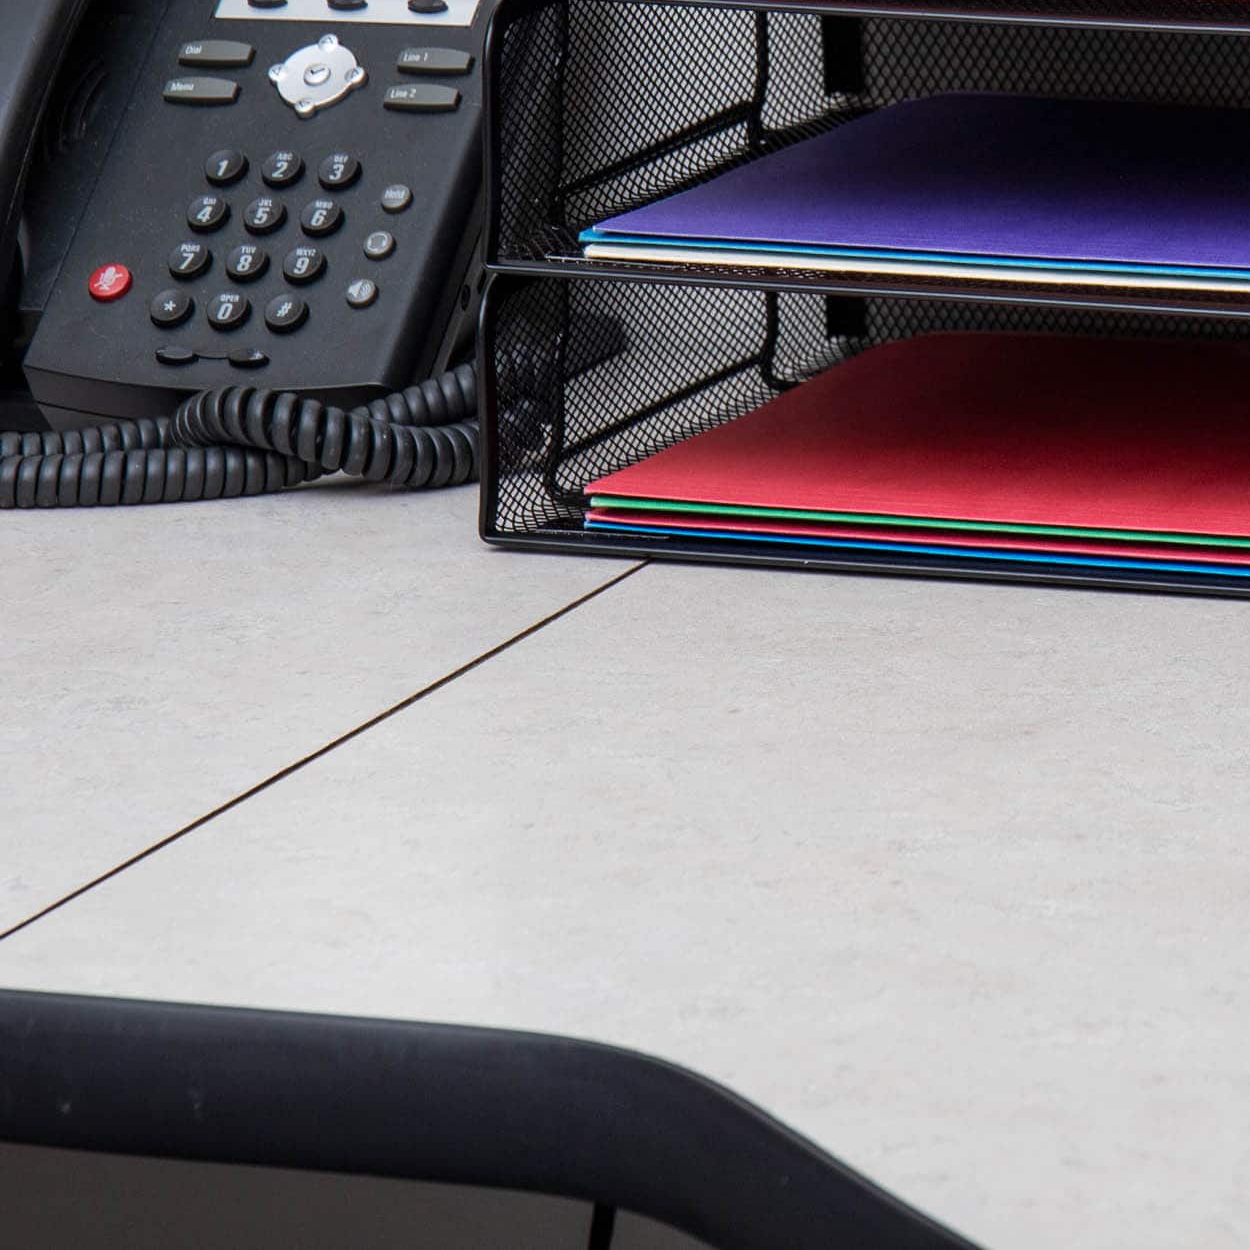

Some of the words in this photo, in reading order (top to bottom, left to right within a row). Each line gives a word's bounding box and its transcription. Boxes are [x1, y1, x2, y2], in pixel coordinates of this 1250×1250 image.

[185, 45, 202, 55] Dial
[403, 53, 420, 62] Line
[423, 53, 428, 62] 1
[170, 81, 194, 92] Menu
[390, 89, 408, 99] Line
[409, 89, 417, 99] 2
[217, 159, 229, 177] 1
[271, 162, 287, 179] 2
[329, 163, 344, 181] 3
[384, 188, 406, 200] Hold
[197, 206, 211, 223] 4
[254, 207, 269, 225] 5
[311, 209, 326, 227] 6
[180, 253, 194, 270] 7
[236, 254, 252, 272] 8
[293, 257, 310, 274] 9
[216, 302, 232, 320] 0
